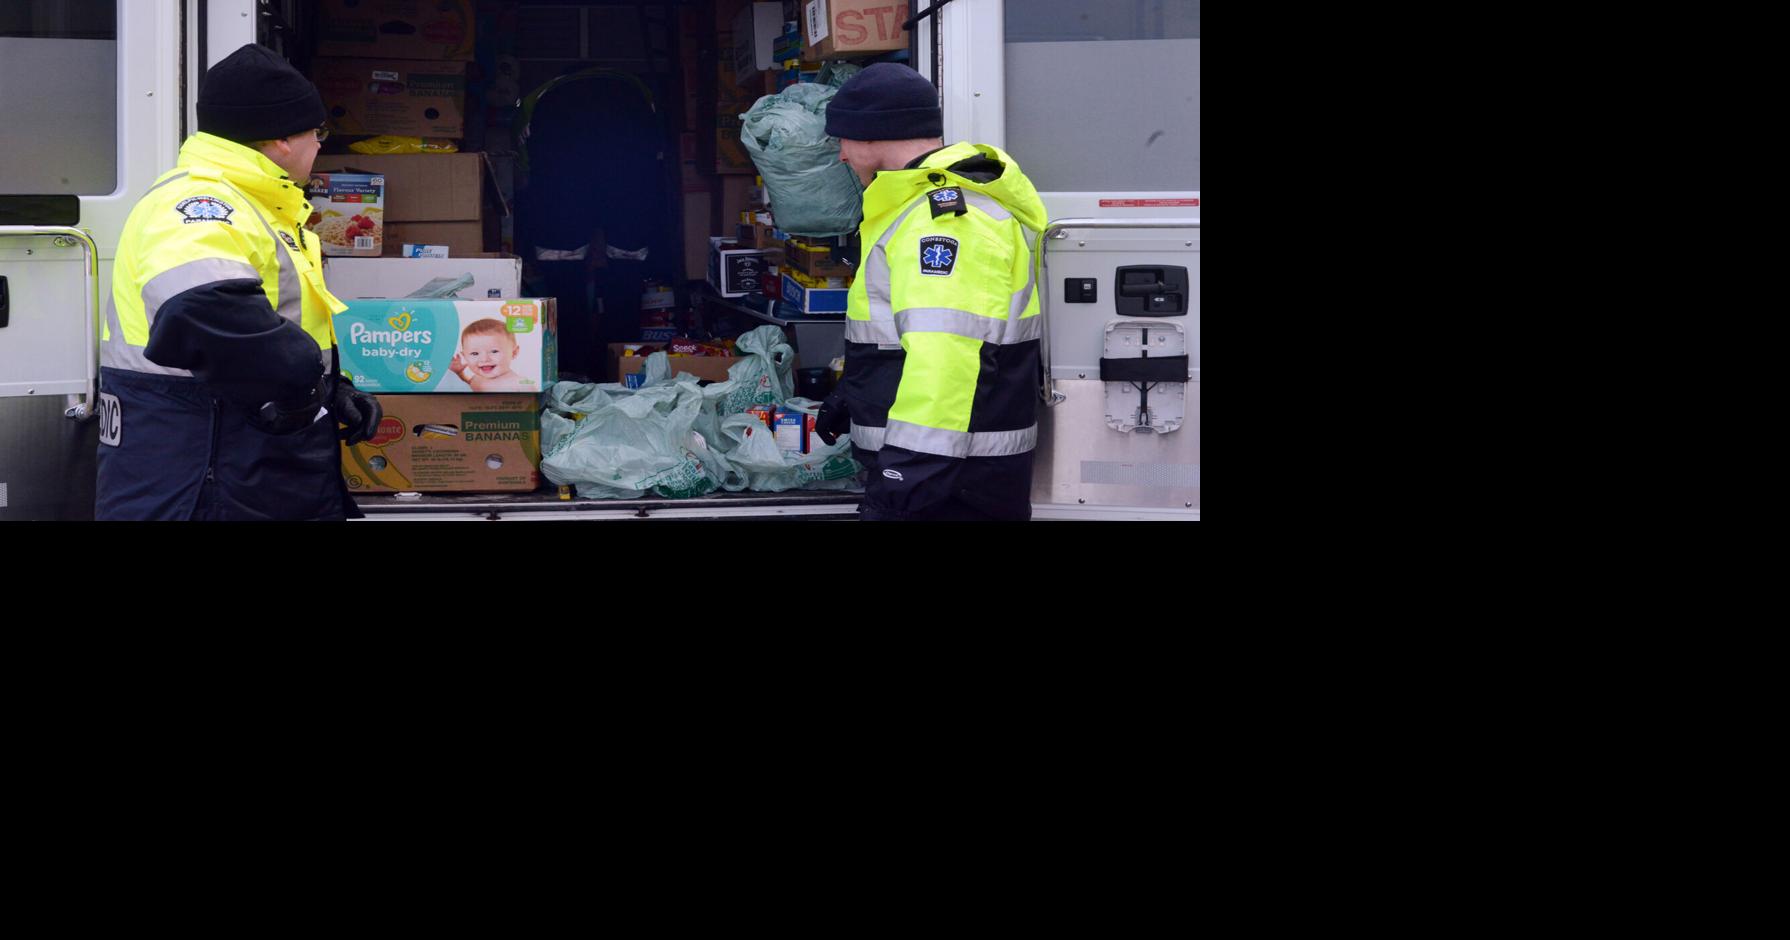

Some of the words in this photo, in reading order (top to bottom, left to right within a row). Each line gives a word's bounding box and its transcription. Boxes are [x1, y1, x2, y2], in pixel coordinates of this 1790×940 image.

[350, 322, 432, 347] Pampers
[362, 347, 422, 358] baby-dry
[378, 425, 402, 434] onte
[465, 420, 521, 430] Premium
[465, 431, 529, 441] BANANAS
